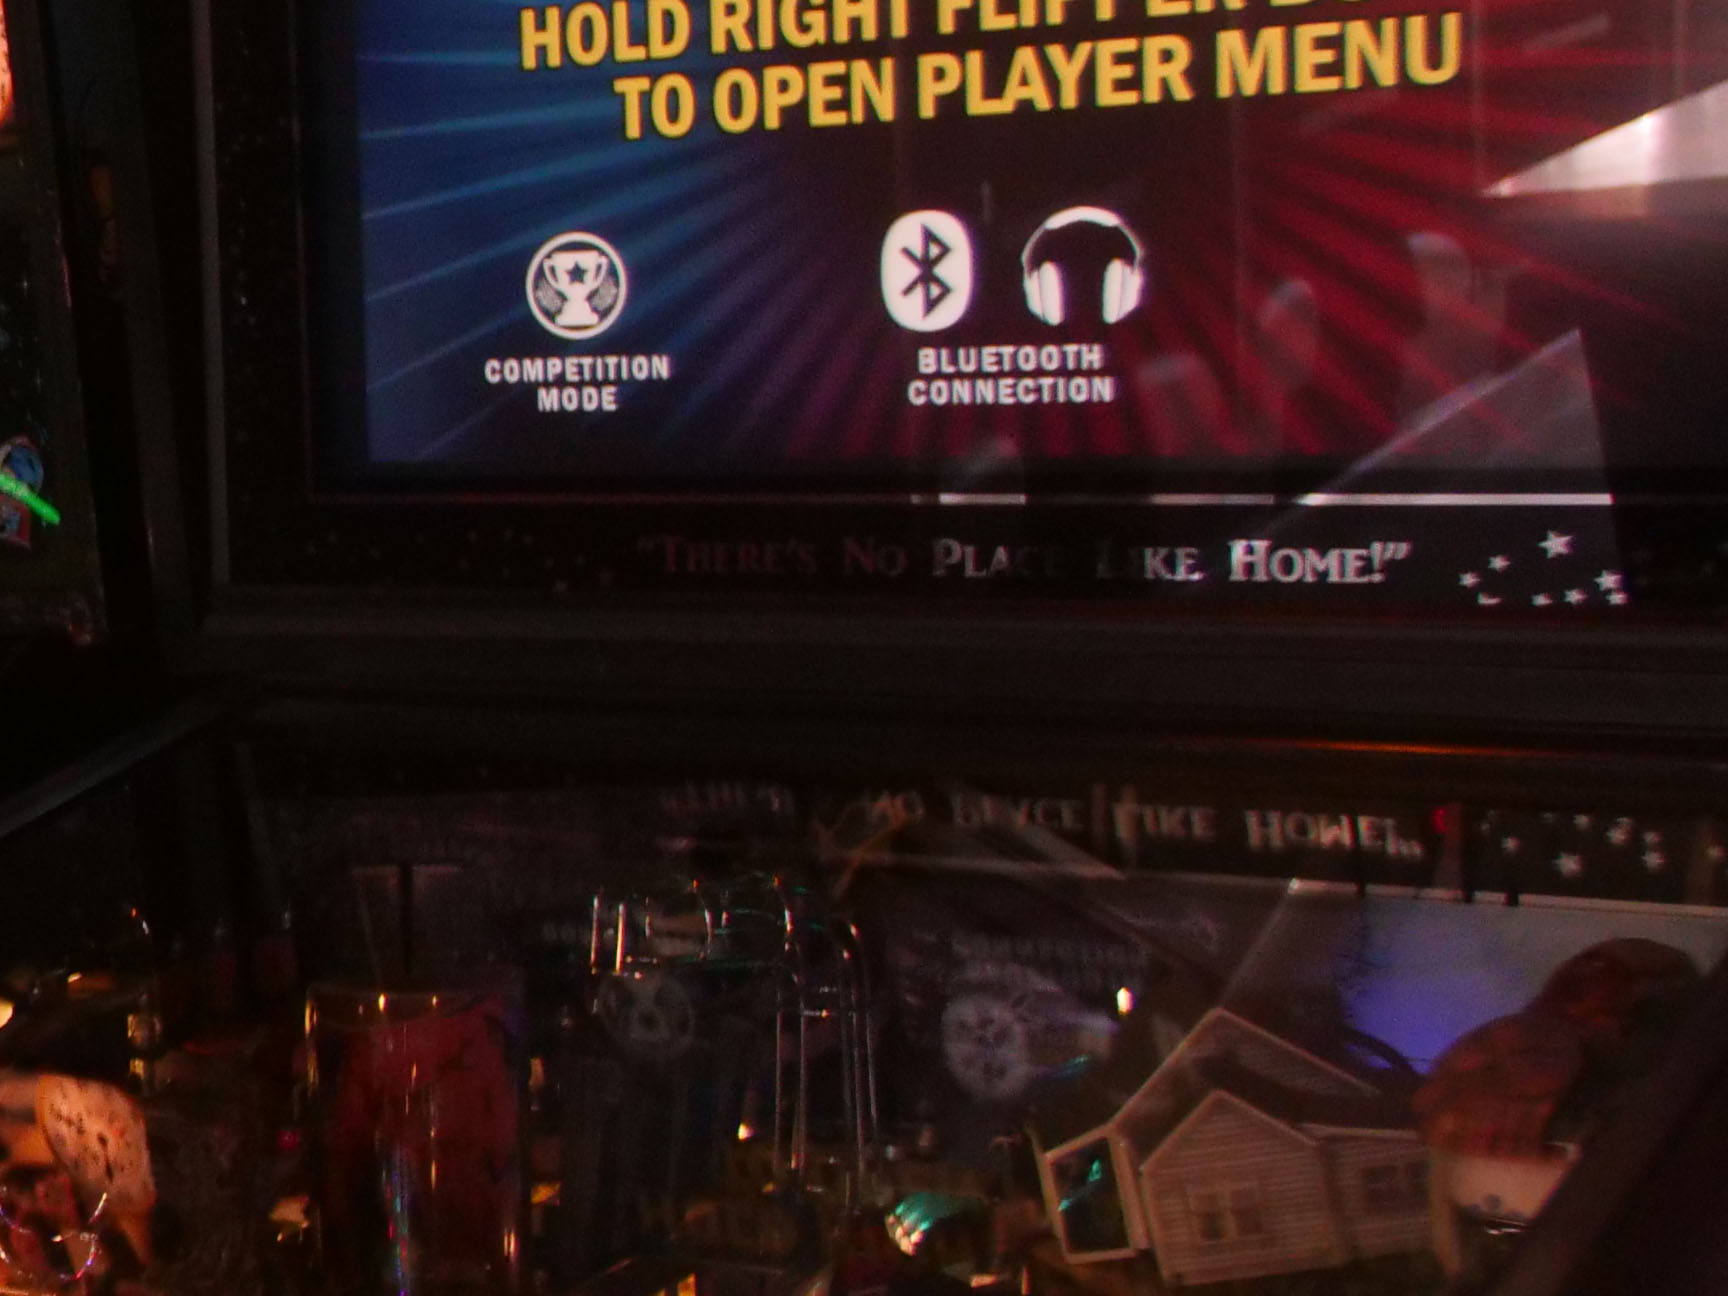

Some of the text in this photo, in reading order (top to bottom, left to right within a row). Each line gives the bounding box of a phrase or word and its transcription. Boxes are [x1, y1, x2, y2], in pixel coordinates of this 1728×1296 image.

[614, 10, 1463, 140] TO OPEN PLAYER MENU
[485, 355, 671, 384] COMPETITION
[916, 344, 1103, 374] BLUETOOTH
[537, 387, 618, 412] MODE
[906, 376, 1115, 406] CONNECTION
